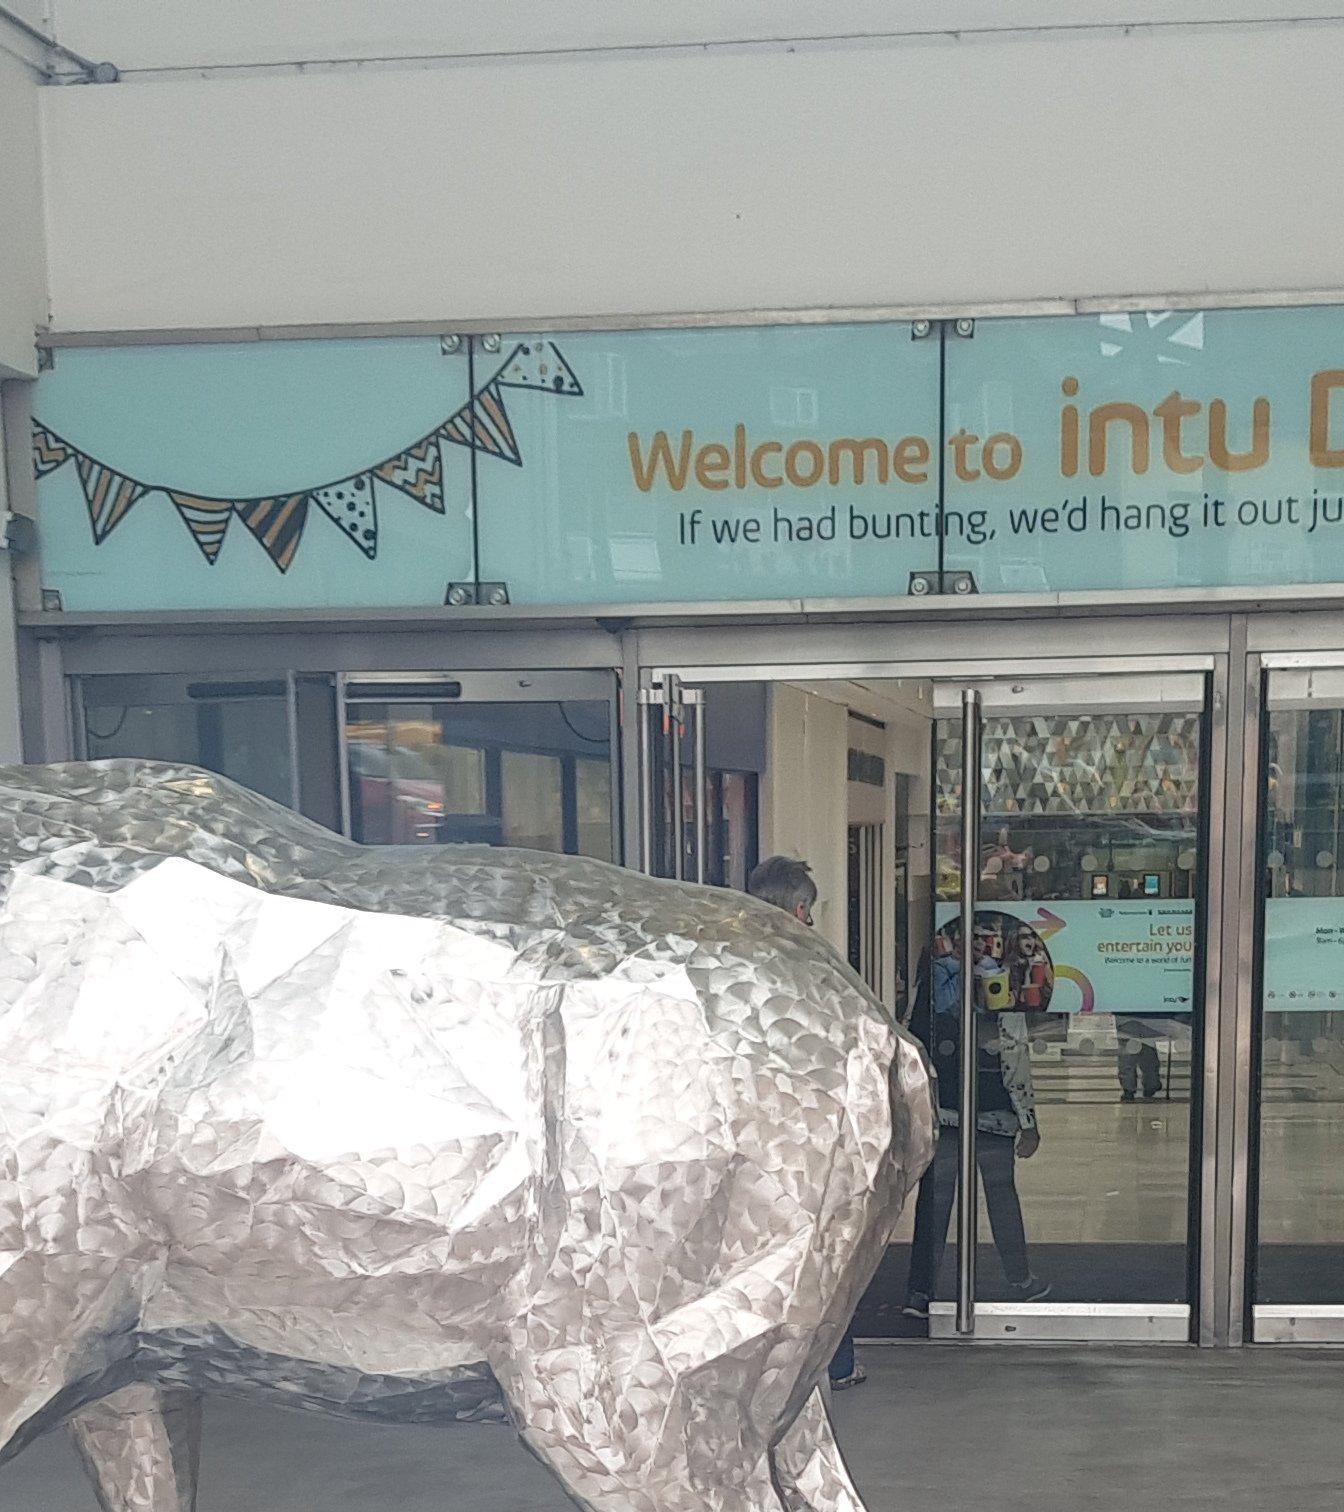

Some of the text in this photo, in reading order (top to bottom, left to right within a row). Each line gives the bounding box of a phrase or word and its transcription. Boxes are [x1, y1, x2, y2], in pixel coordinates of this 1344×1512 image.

[627, 423, 931, 493] Welcome
[948, 428, 1023, 481] to
[1060, 376, 1271, 478] intu
[678, 510, 704, 545] If
[712, 520, 761, 544] we
[772, 506, 837, 542] had
[849, 501, 997, 543] bunting,
[1009, 495, 1089, 536] we'd
[1099, 496, 1191, 538] hang
[1202, 492, 1227, 527] it
[1237, 495, 1300, 527] out
[1097, 939, 1193, 956] entertain you
[1149, 923, 1193, 937] Let us
